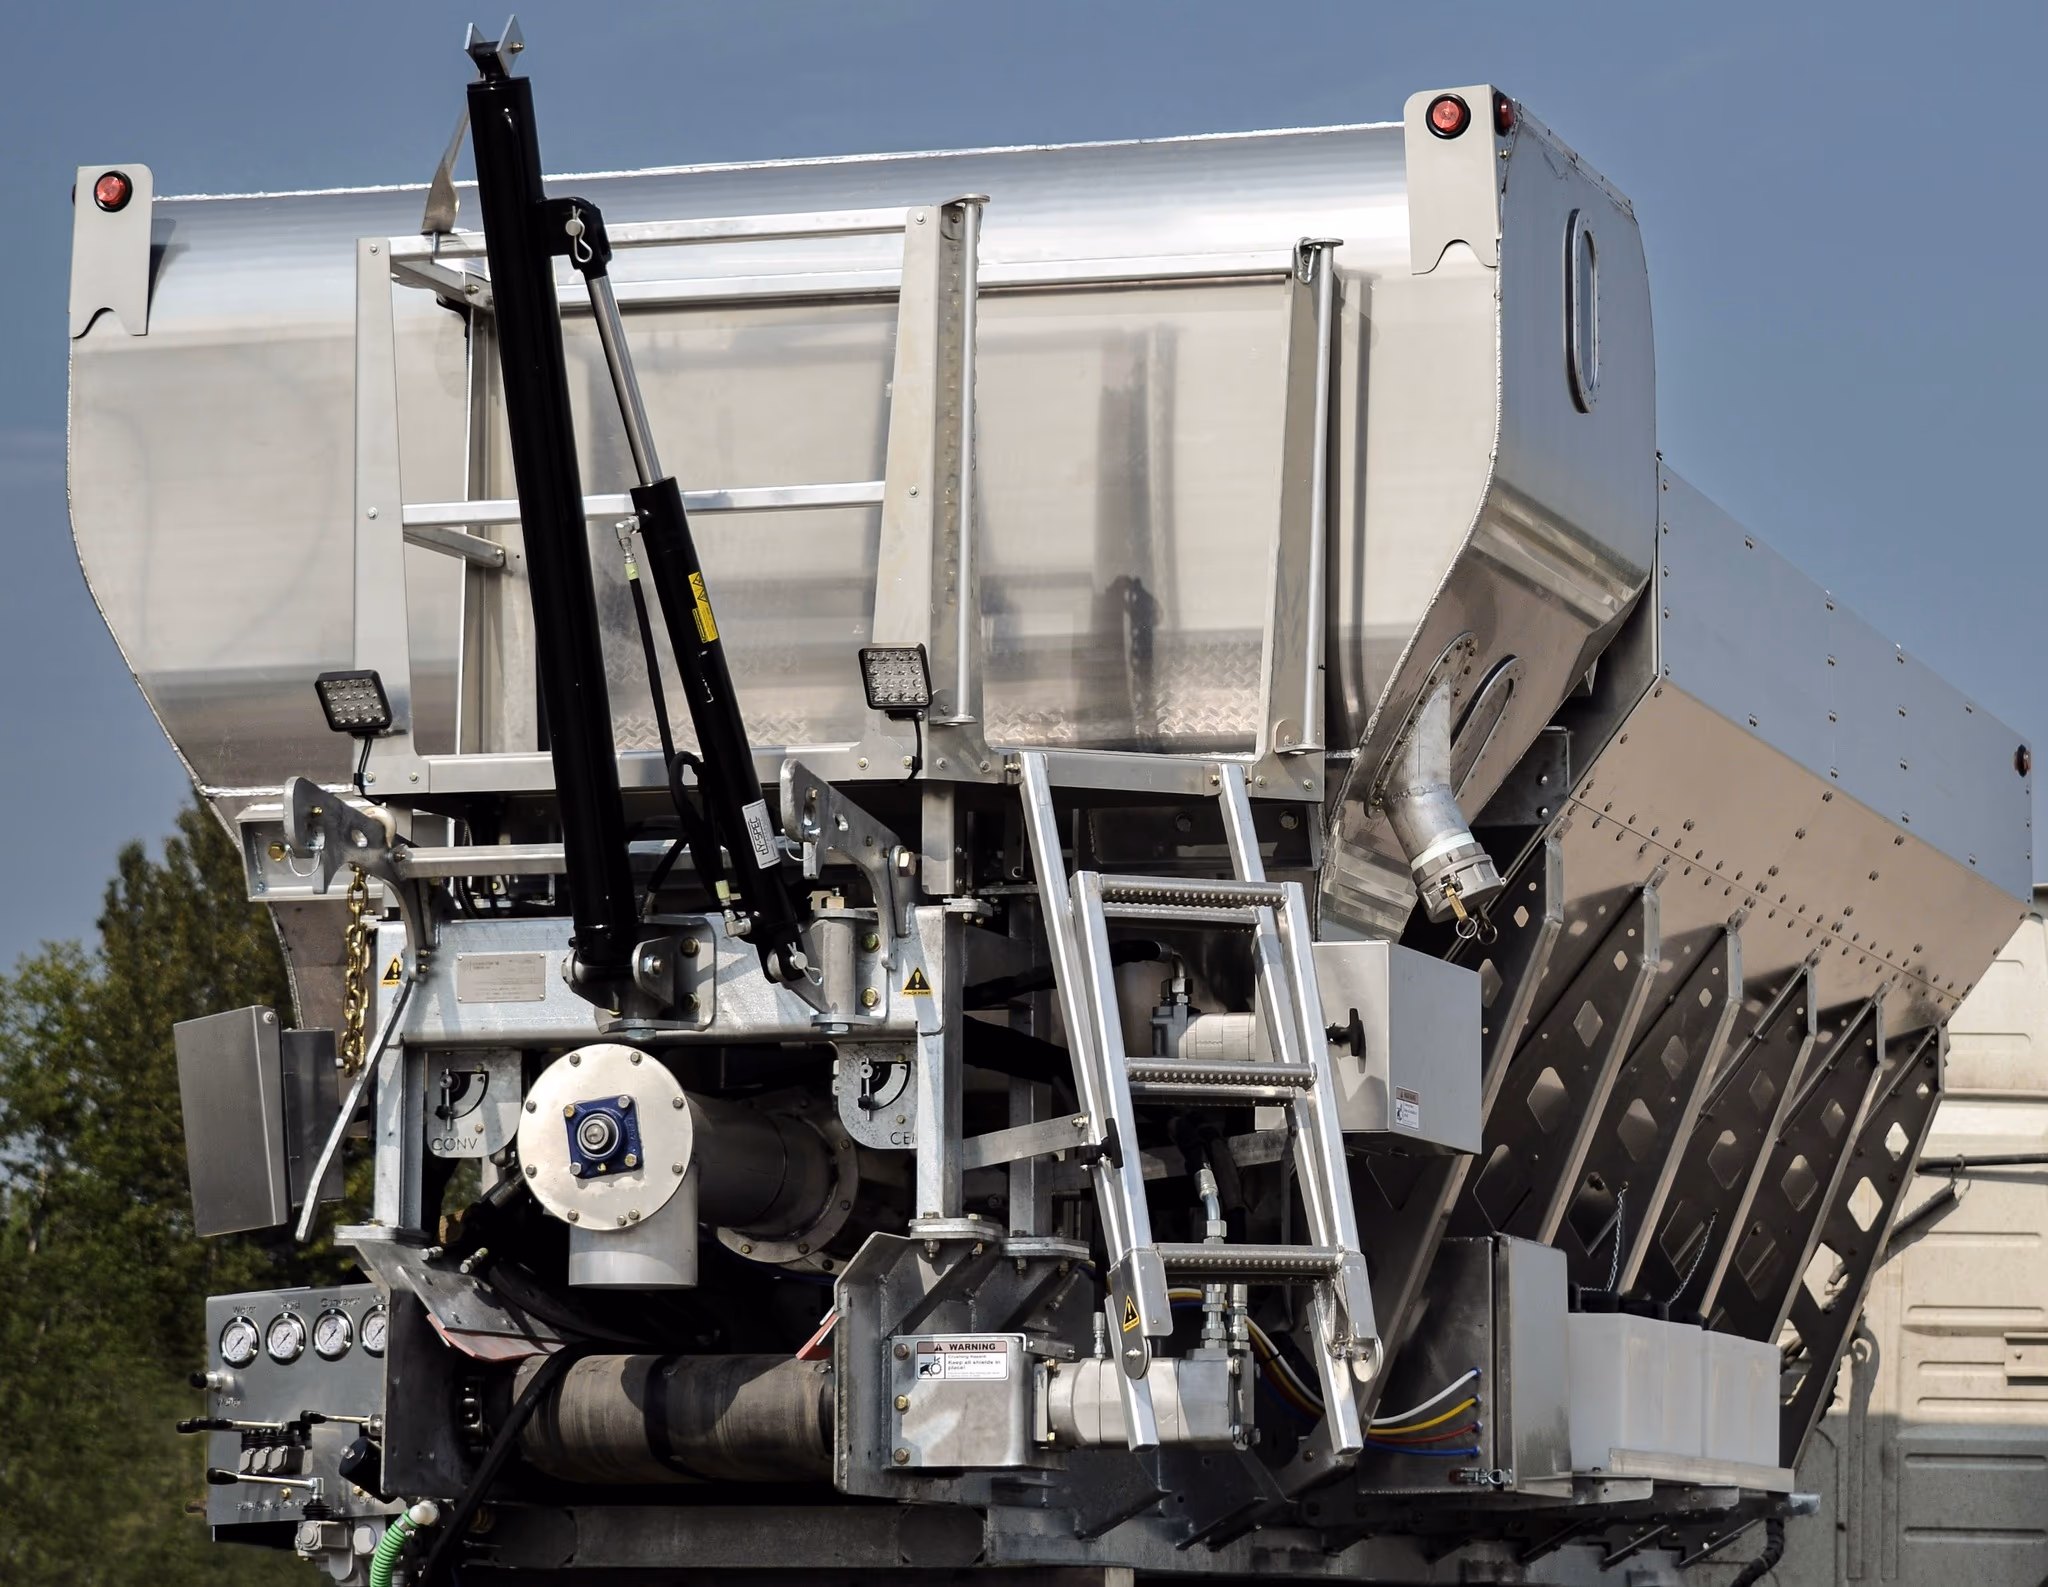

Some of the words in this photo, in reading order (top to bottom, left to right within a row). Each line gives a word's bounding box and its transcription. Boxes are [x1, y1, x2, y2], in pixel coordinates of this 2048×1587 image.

[747, 815, 769, 856] HY-SPEC
[431, 1137, 478, 1151] CONV
[890, 1131, 915, 1146] CE
[949, 1343, 996, 1351] WARNING
